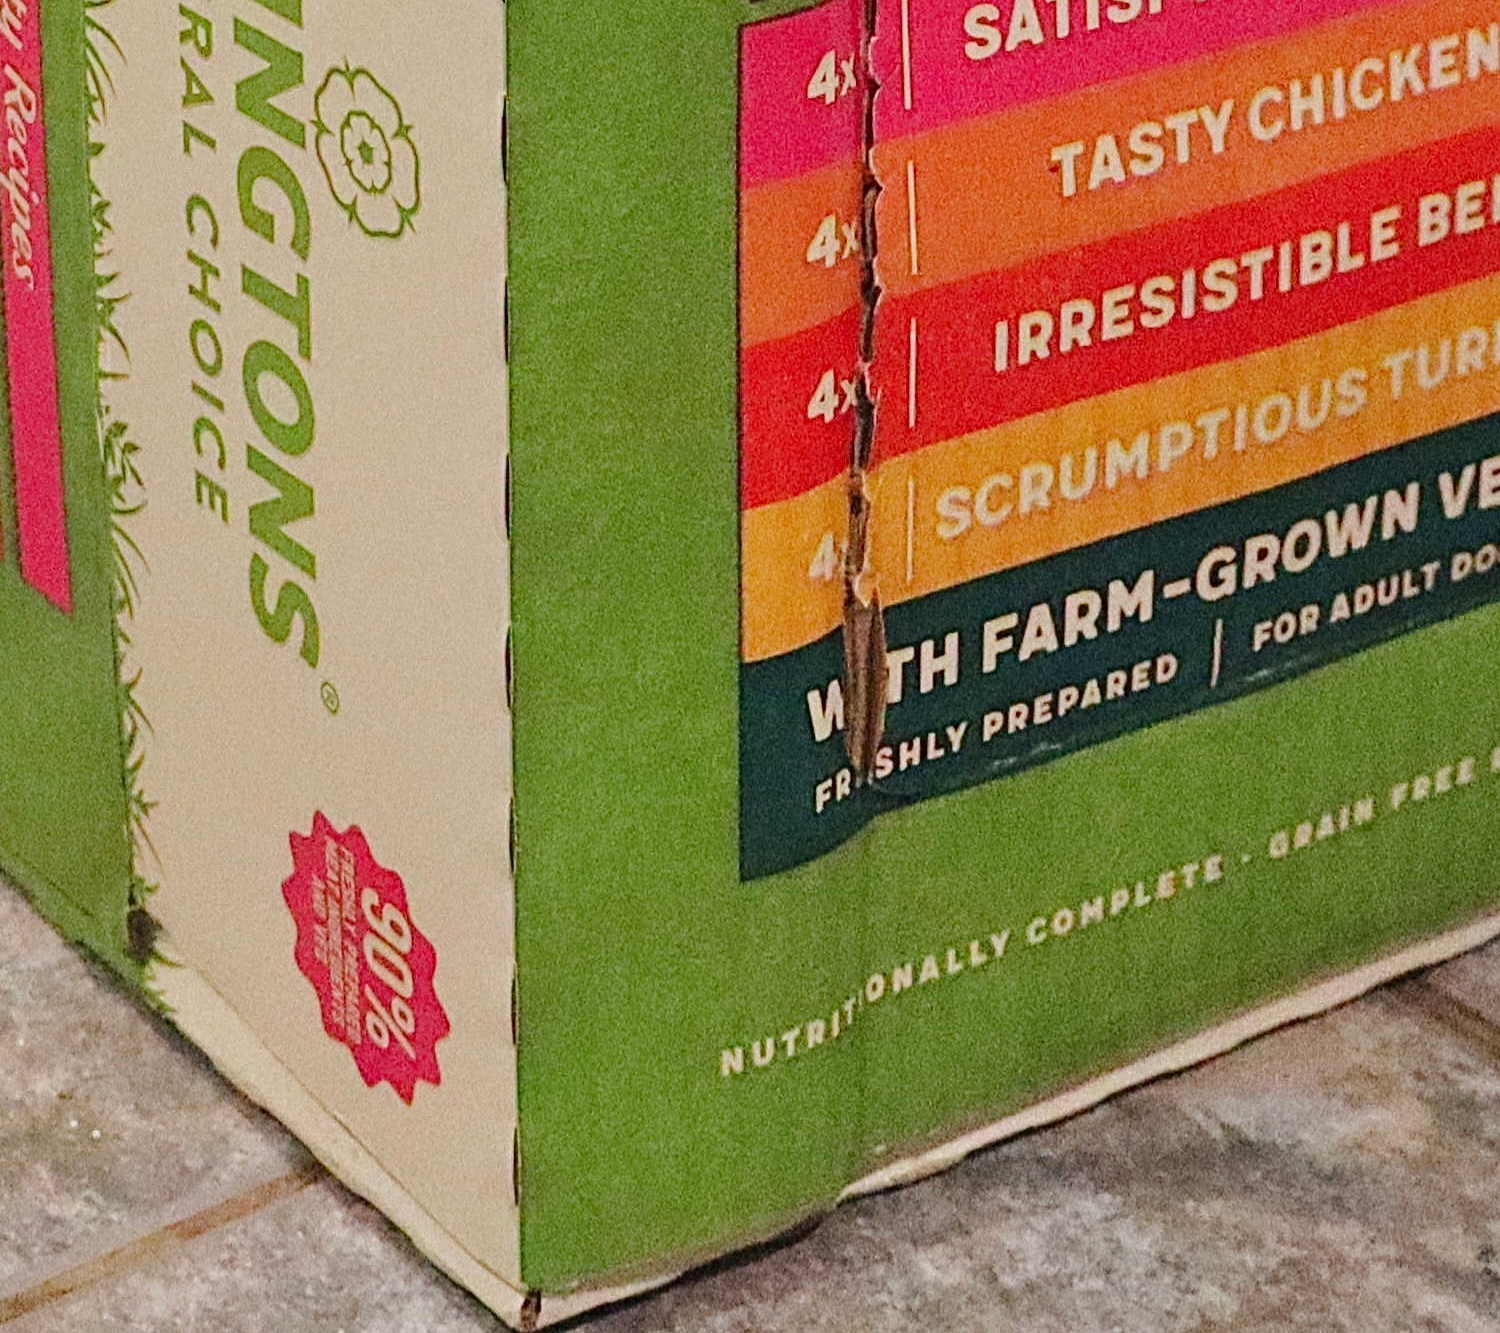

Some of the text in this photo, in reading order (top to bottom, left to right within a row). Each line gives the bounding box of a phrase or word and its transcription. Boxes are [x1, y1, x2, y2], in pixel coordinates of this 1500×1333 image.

[1050, 98, 1238, 199] TASTY
[185, 193, 230, 524] CHOICE
[993, 194, 1400, 373] IRRESISTIBLE
[935, 367, 1370, 540] SCRUMPTIOUS
[806, 631, 960, 743] WTH
[980, 480, 1421, 676] FARM-GROWN
[814, 721, 969, 814] FRSHLY
[982, 654, 1180, 742] PREPARED
[1250, 603, 1322, 653] FOR
[1329, 558, 1440, 624] ADULT
[360, 886, 417, 1061] 90%
[720, 928, 1011, 1077] NUTRITIONALLY
[1026, 852, 1225, 946] COMPLETE
[1268, 796, 1378, 861] GRAIN
[1390, 757, 1477, 813] FREE
